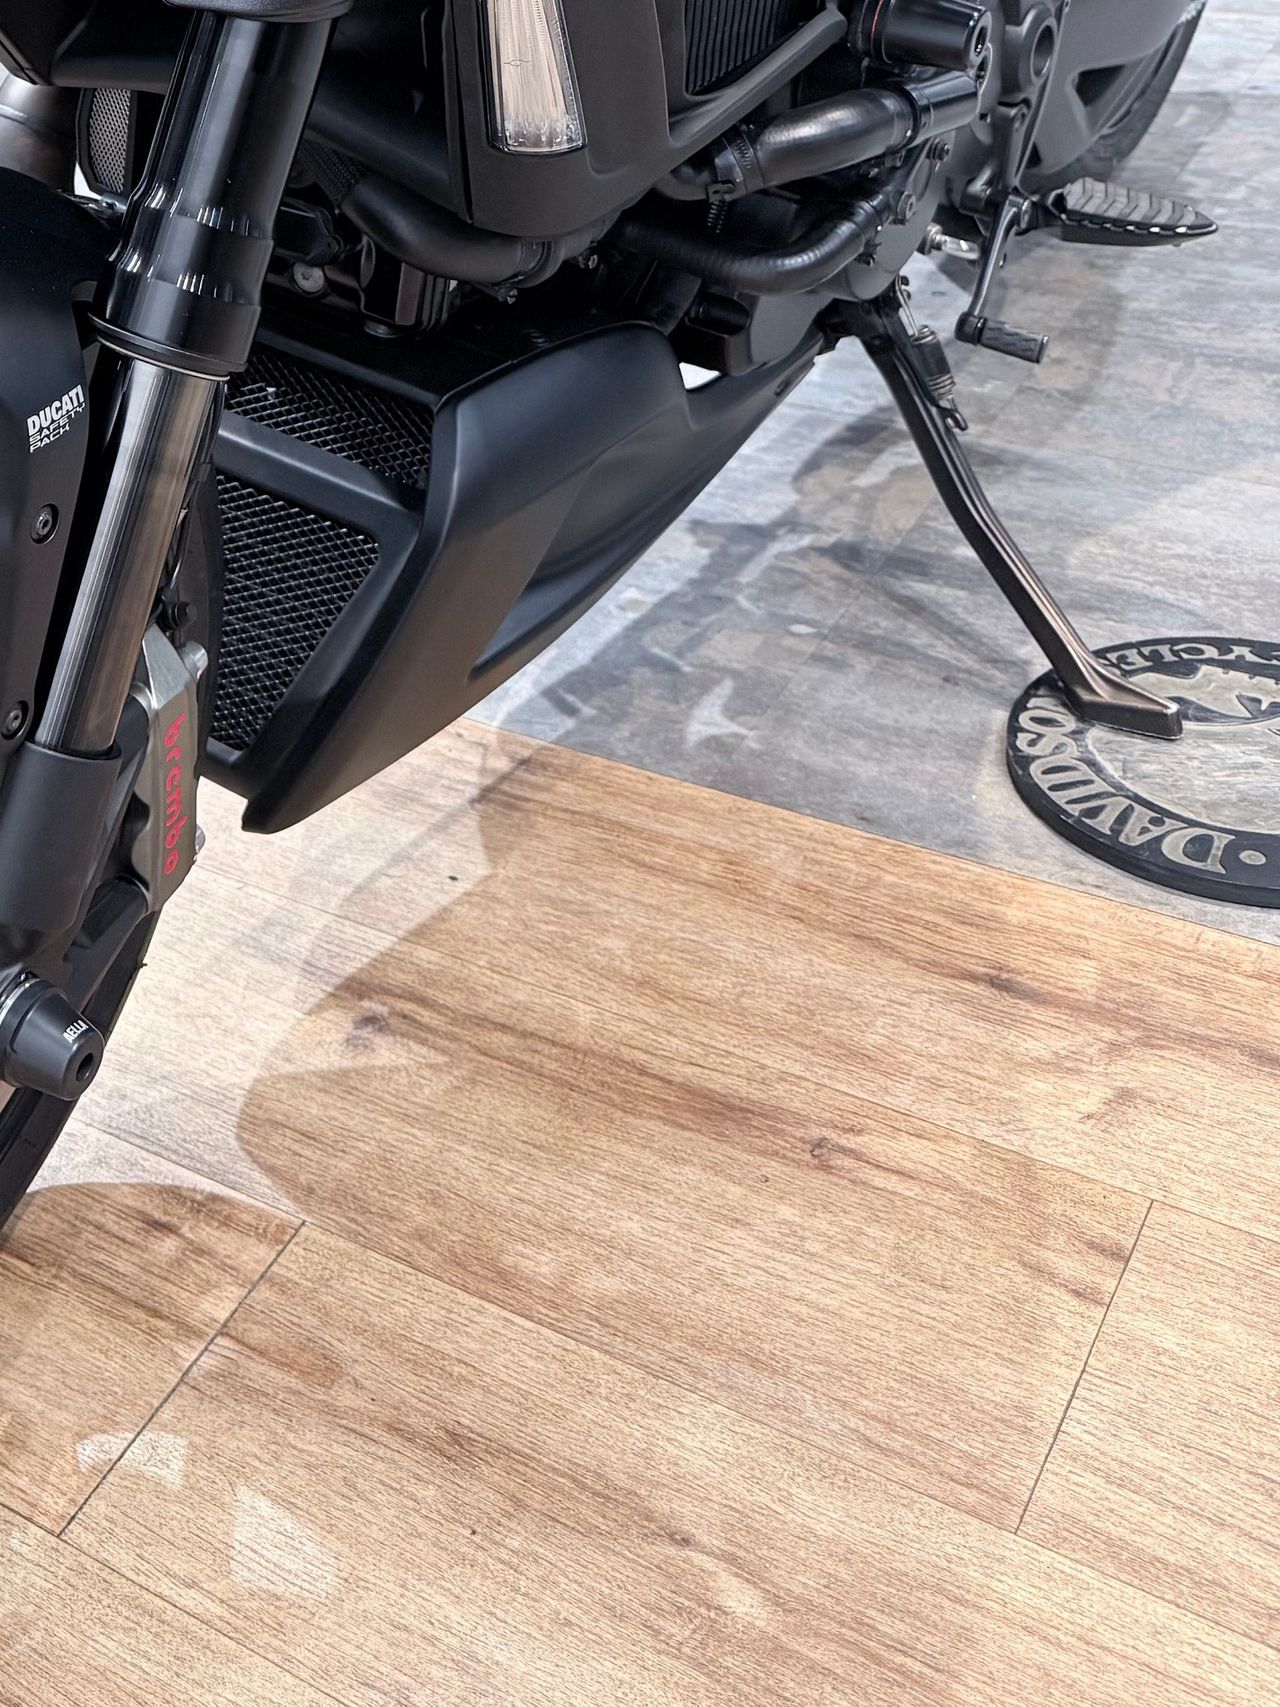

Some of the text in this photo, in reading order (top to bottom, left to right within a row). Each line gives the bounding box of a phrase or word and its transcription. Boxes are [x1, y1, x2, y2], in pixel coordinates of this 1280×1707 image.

[26, 384, 85, 436] DUCATI
[29, 402, 86, 445] SAFETY
[29, 423, 70, 453] PACK
[164, 712, 188, 874] brembo
